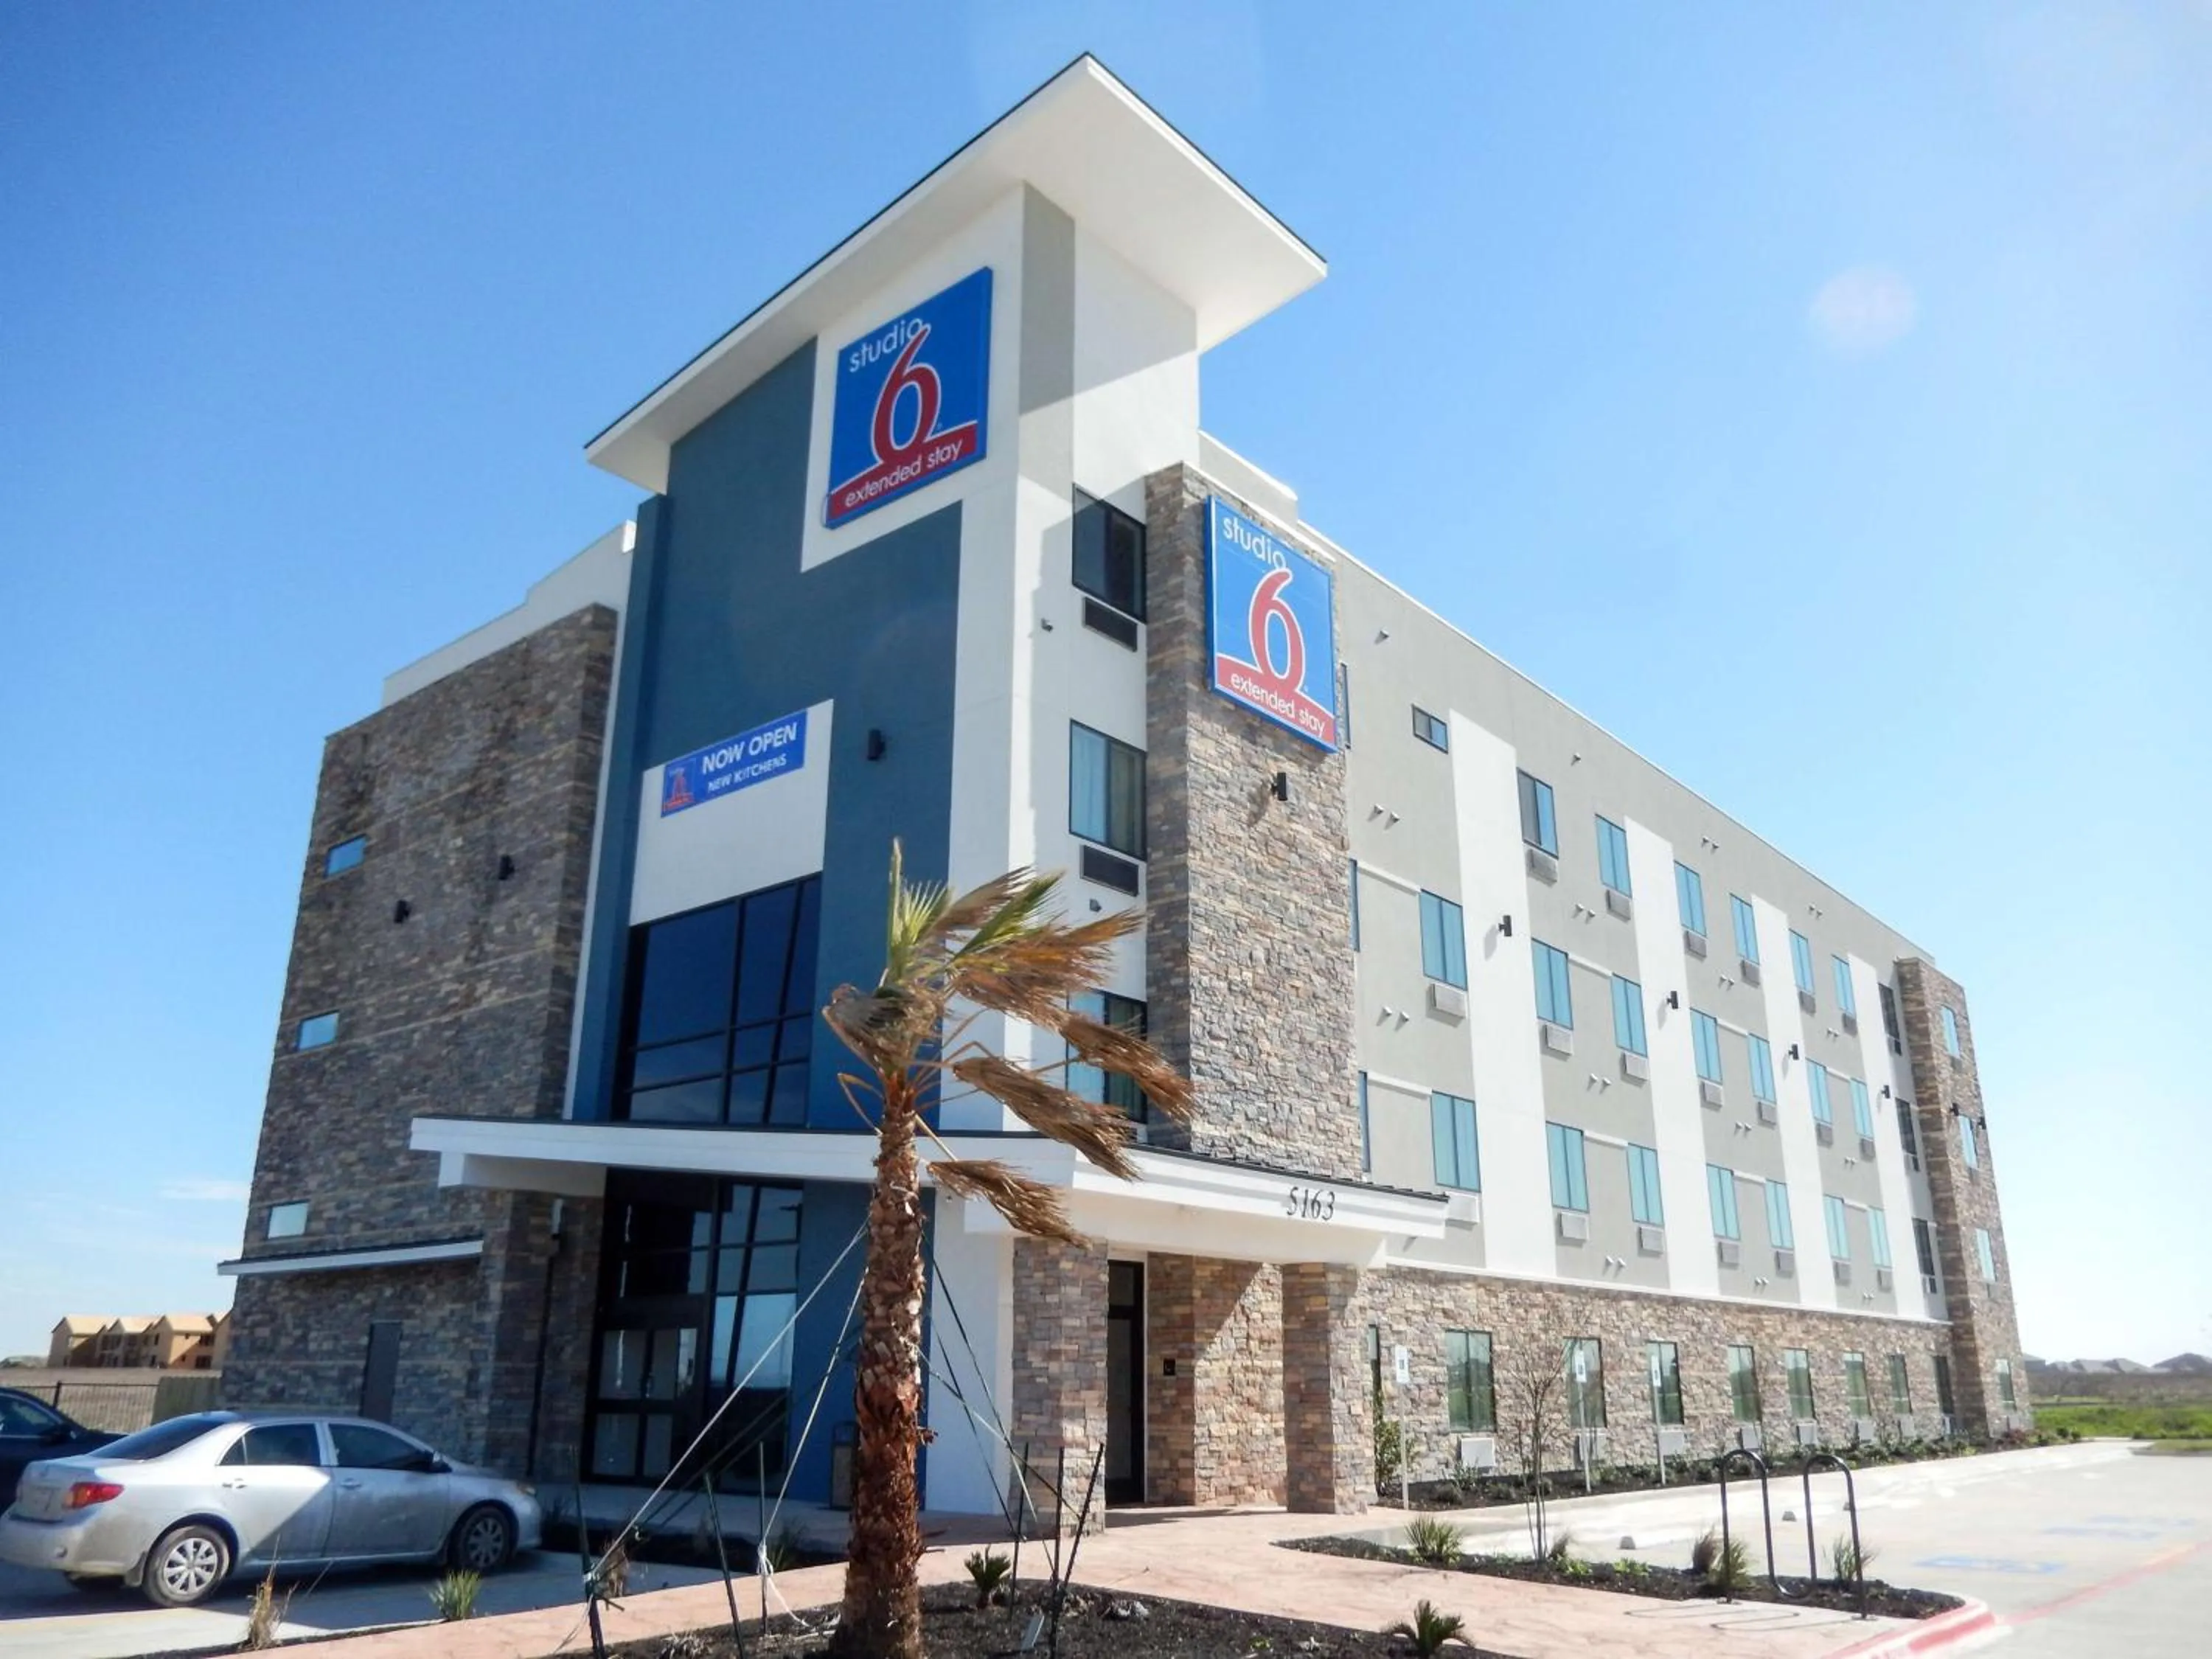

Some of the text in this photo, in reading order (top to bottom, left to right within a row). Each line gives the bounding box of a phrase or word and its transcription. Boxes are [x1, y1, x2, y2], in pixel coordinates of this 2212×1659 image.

[849, 318, 924, 372] studio
[870, 322, 943, 465] 6
[844, 439, 963, 507] extended stay
[1223, 517, 1287, 570] studio
[1248, 567, 1306, 691] 6
[1231, 672, 1326, 738] extended stay
[702, 721, 798, 774] NOW OPEN
[707, 773, 732, 793] NEW
[733, 753, 787, 783] KITCHENS
[1286, 1186, 1335, 1221] 5163
